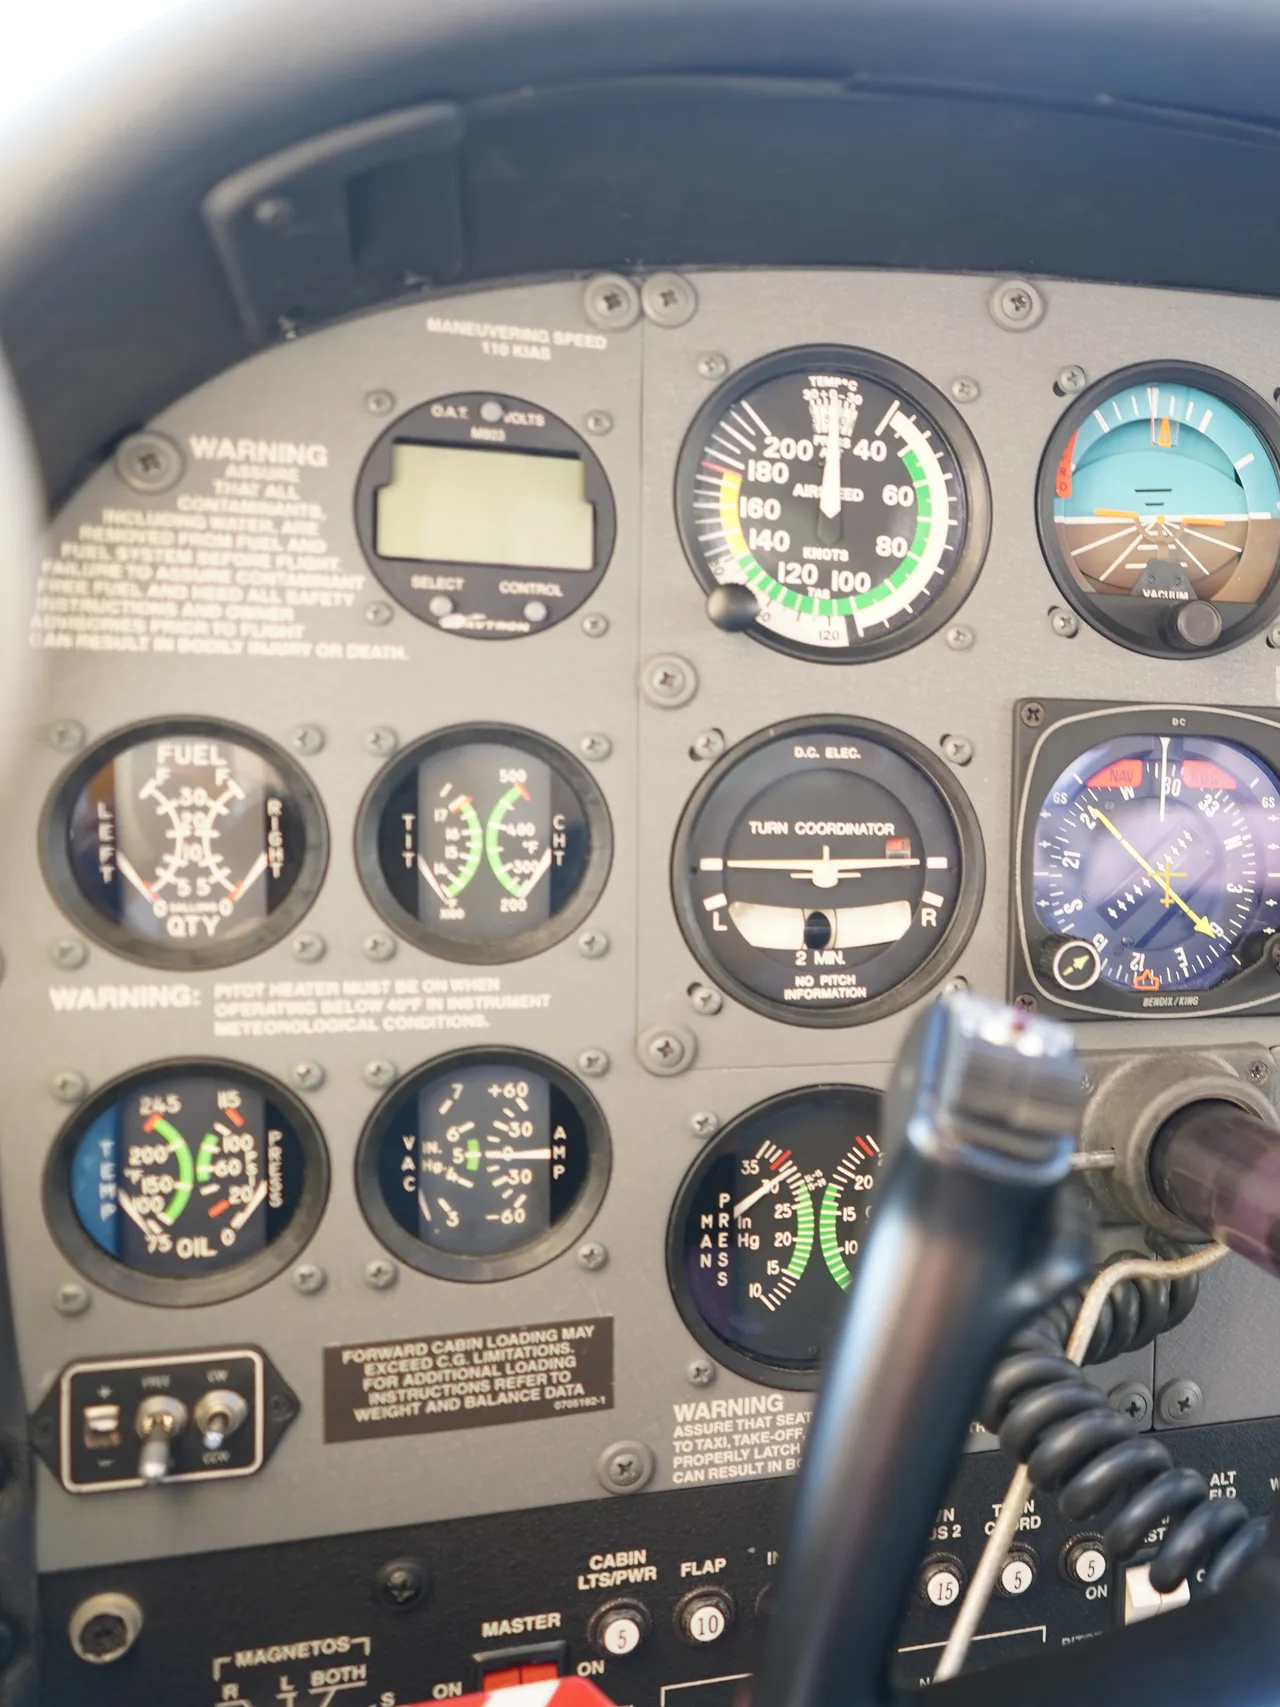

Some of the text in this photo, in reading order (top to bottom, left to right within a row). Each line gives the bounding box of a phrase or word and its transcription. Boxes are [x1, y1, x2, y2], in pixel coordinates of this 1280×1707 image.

[426, 317, 607, 349] MANEUVERING SPEED
[512, 343, 551, 361] KIAS
[190, 435, 328, 467] WARNING
[764, 436, 813, 461] 200
[853, 439, 887, 462] 40
[748, 460, 789, 483] 180
[883, 485, 914, 507] 60
[740, 497, 781, 520] 160
[749, 529, 790, 552] 140
[876, 536, 908, 558] 80
[802, 547, 849, 562] KNOTS
[410, 574, 466, 591] SELECT
[778, 562, 818, 585] 120
[831, 570, 871, 593] 100
[499, 580, 564, 597] CONTROL
[315, 643, 344, 658] OR
[346, 643, 409, 660] DEATH.
[1172, 718, 1186, 727] DC
[157, 742, 228, 766] FUEL
[794, 747, 861, 759] D.C. ELEC.
[499, 768, 527, 783] 500
[1109, 769, 1134, 783] NAV
[1053, 792, 1067, 805] GS
[1198, 794, 1220, 817] 33
[1261, 796, 1275, 809] GS
[506, 822, 535, 837] 400
[749, 821, 895, 836] TURN COORDINATOR
[1061, 850, 1081, 870] 21
[167, 915, 220, 937] QTY
[712, 911, 728, 931] L
[921, 907, 937, 927] R
[795, 951, 846, 966] 2 MIN.
[269, 980, 341, 998] HEATER
[395, 979, 419, 994] BE
[422, 979, 448, 993] ON
[450, 977, 500, 992] WHEN
[795, 974, 856, 987] NO PITCH
[49, 983, 202, 1011] WARNING:
[784, 986, 867, 1000] INFORMATION
[1142, 996, 1199, 1008] BENDIX/KING
[487, 1081, 529, 1098] +60
[508, 1121, 533, 1138] 30
[223, 1133, 254, 1153] 100
[128, 1145, 169, 1166] 200
[215, 1158, 242, 1178] 60
[507, 1168, 533, 1185] 30
[740, 1159, 760, 1175] 35
[854, 1174, 873, 1190] 20
[774, 1203, 792, 1219] 25
[176, 1236, 218, 1258] OIL
[737, 1233, 760, 1251] Hg
[773, 1231, 792, 1247] 20
[342, 1325, 595, 1364] FORWARD CABIN LOADING MAY
[364, 1342, 575, 1376] EXCEED C.G. LIMITATIONS.
[362, 1355, 576, 1391] FOR ADDITIONAL LOADING
[368, 1371, 571, 1405] INSTRUCTIONS REFER TO
[353, 1383, 585, 1422] WEIGHT AND BALANCE DATA
[673, 1394, 784, 1423] WARNING
[673, 1412, 813, 1438] ASSURE THAT SEAT
[672, 1427, 806, 1453] TO TAXI, TAKE-OFF,
[673, 1442, 801, 1469] PROPERLY LATCH
[672, 1460, 782, 1484] CAN RESULT IN
[1210, 1471, 1237, 1486] ALT
[589, 1550, 647, 1571] CABIN
[680, 1558, 727, 1578] FLAP
[1088, 1560, 1095, 1578] 5
[578, 1566, 657, 1590] LTS/PWR
[1014, 1571, 1022, 1589] 5
[937, 1582, 953, 1600] 15
[1086, 1584, 1108, 1600] ON
[482, 1612, 561, 1638] MASTER
[697, 1615, 719, 1636] 10
[618, 1629, 627, 1649] 5
[235, 1636, 351, 1667] MAGNETOS
[310, 1664, 367, 1687] BOTH
[577, 1659, 605, 1677] ON
[432, 1682, 463, 1700] ON
